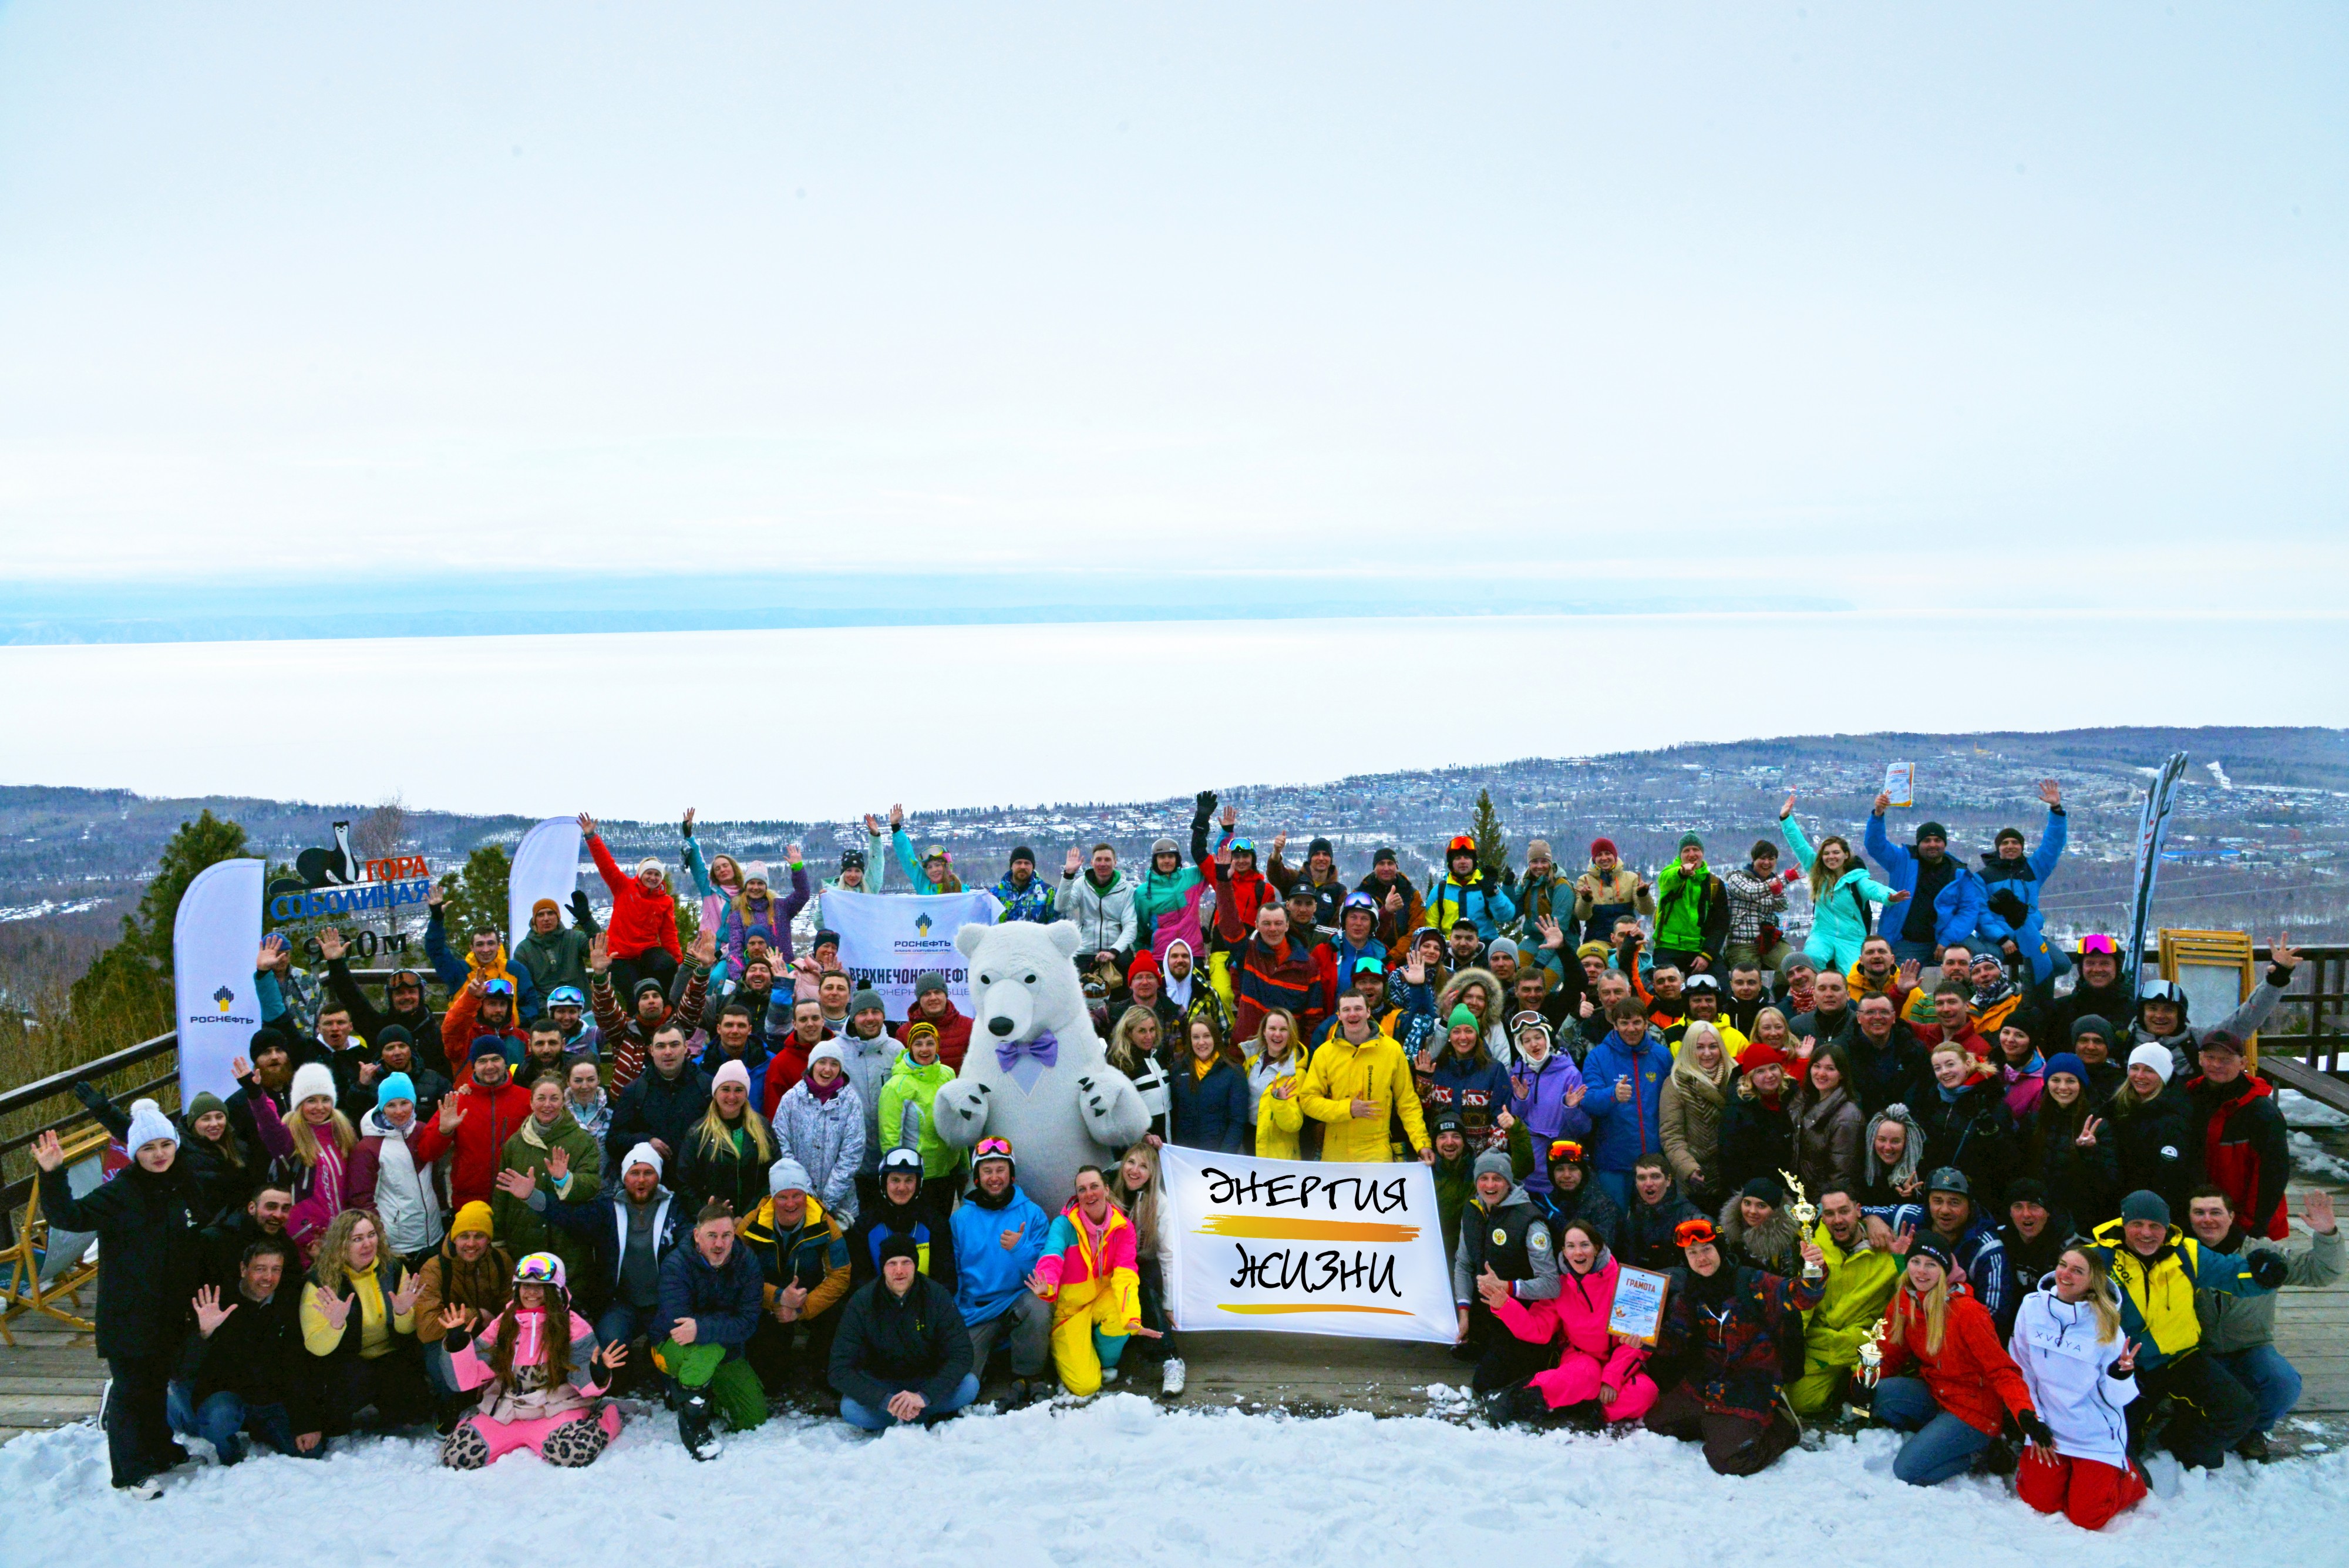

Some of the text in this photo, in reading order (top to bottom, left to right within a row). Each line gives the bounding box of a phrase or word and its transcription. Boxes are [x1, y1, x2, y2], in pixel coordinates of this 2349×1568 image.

[365, 855, 429, 882] ГОРА
[270, 879, 430, 921] СОБОЛИНАЯ
[190, 1016, 254, 1024] РОСНЕФТЬ
[1201, 1167, 1408, 1213] ЭНЕРГИЯ
[1230, 1243, 1401, 1297] ЖИЗНИ
[1626, 1278, 1655, 1293] ГРАМОТА
[2035, 1331, 2081, 1352] XVOYA
